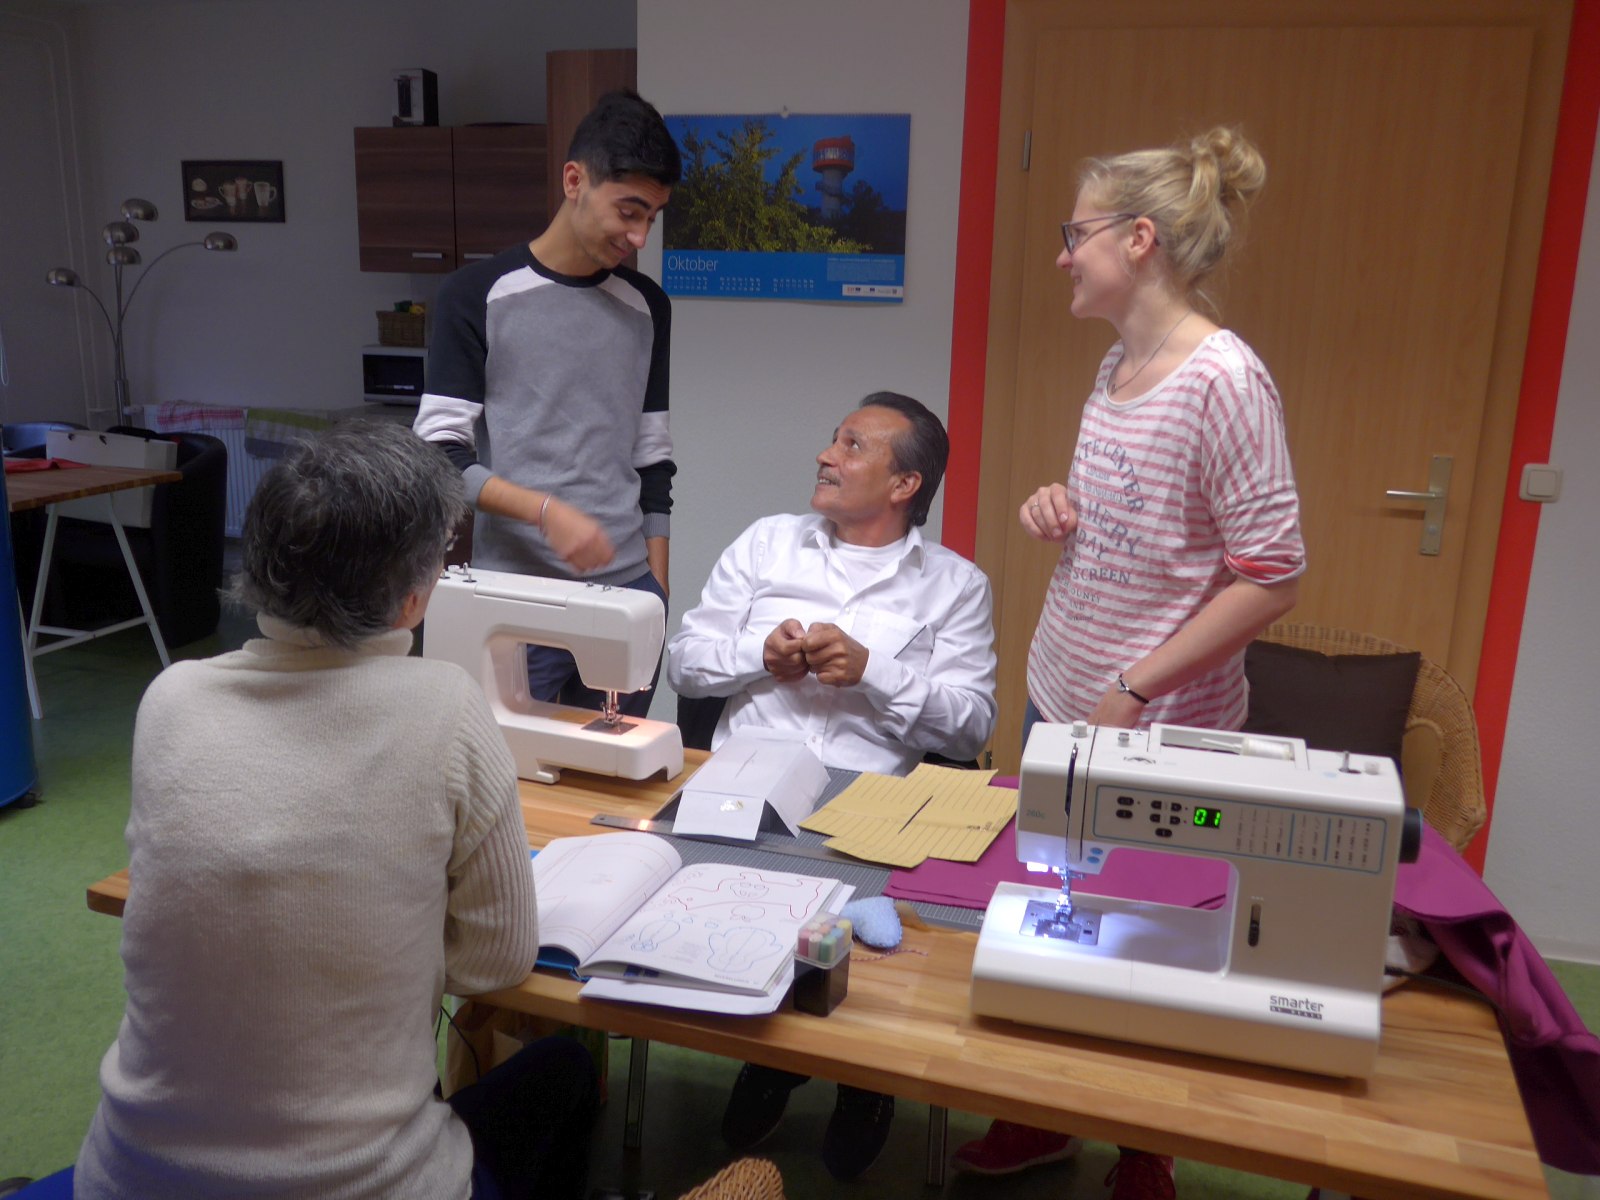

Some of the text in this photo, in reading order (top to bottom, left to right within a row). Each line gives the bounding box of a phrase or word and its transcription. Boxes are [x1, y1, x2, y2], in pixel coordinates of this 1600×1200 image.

[667, 255, 718, 272] Oktober
[1076, 528, 1109, 560] DAY
[1072, 566, 1131, 585] SCREEN
[1194, 808, 1221, 827] 01
[1270, 994, 1324, 1012] smarter
